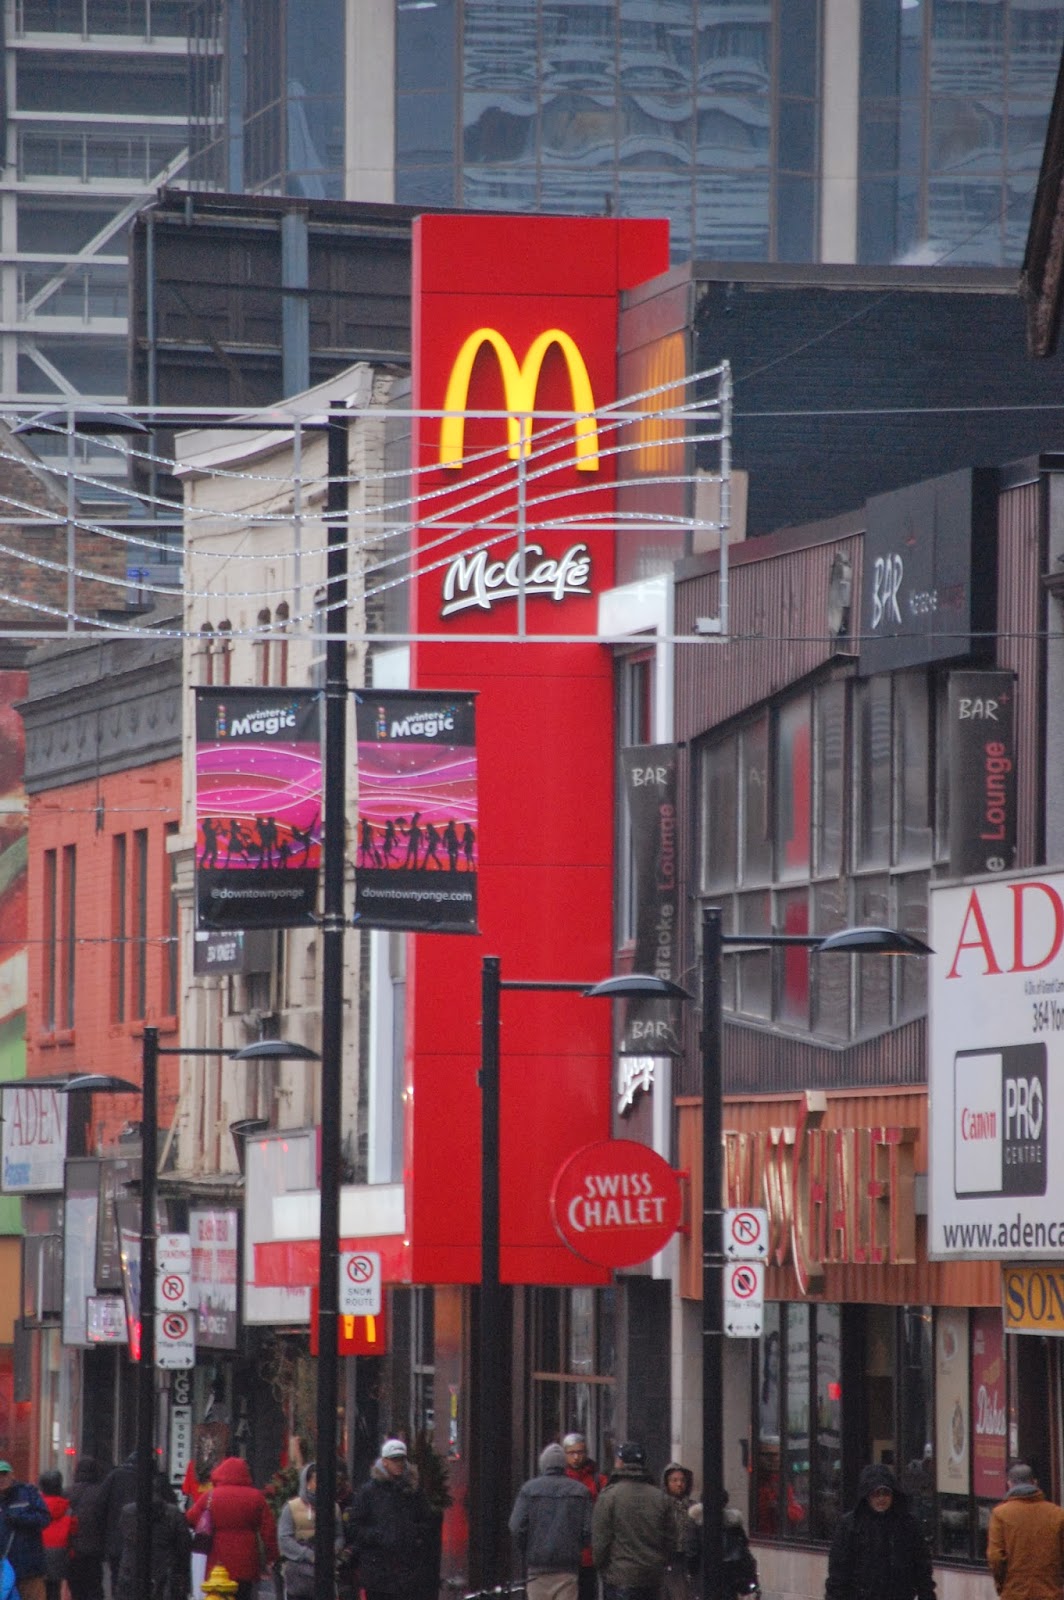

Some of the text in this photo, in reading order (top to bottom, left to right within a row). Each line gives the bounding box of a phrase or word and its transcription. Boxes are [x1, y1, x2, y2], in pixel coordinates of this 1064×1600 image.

[442, 544, 590, 610] McCafé
[230, 714, 296, 736] Magic
[246, 709, 282, 720] winter
[406, 712, 440, 722] winter
[390, 717, 454, 738] Magic
[980, 741, 1012, 841] Lounge
[210, 888, 305, 900] @downtownyonge
[361, 887, 472, 902] downtownyonge.com
[655, 803, 675, 981] araoke Lounge
[10, 1088, 62, 1146] ADEN
[1005, 1076, 1043, 1140] PRO
[962, 1107, 996, 1141] Canon
[1006, 1145, 1042, 1165] CENTRE
[584, 1172, 653, 1199] SWISS
[568, 1195, 667, 1232] CHALET
[345, 1298, 374, 1307] ROUTE
[347, 1288, 372, 1296] SNOW
[178, 1424, 186, 1469] SOREL
